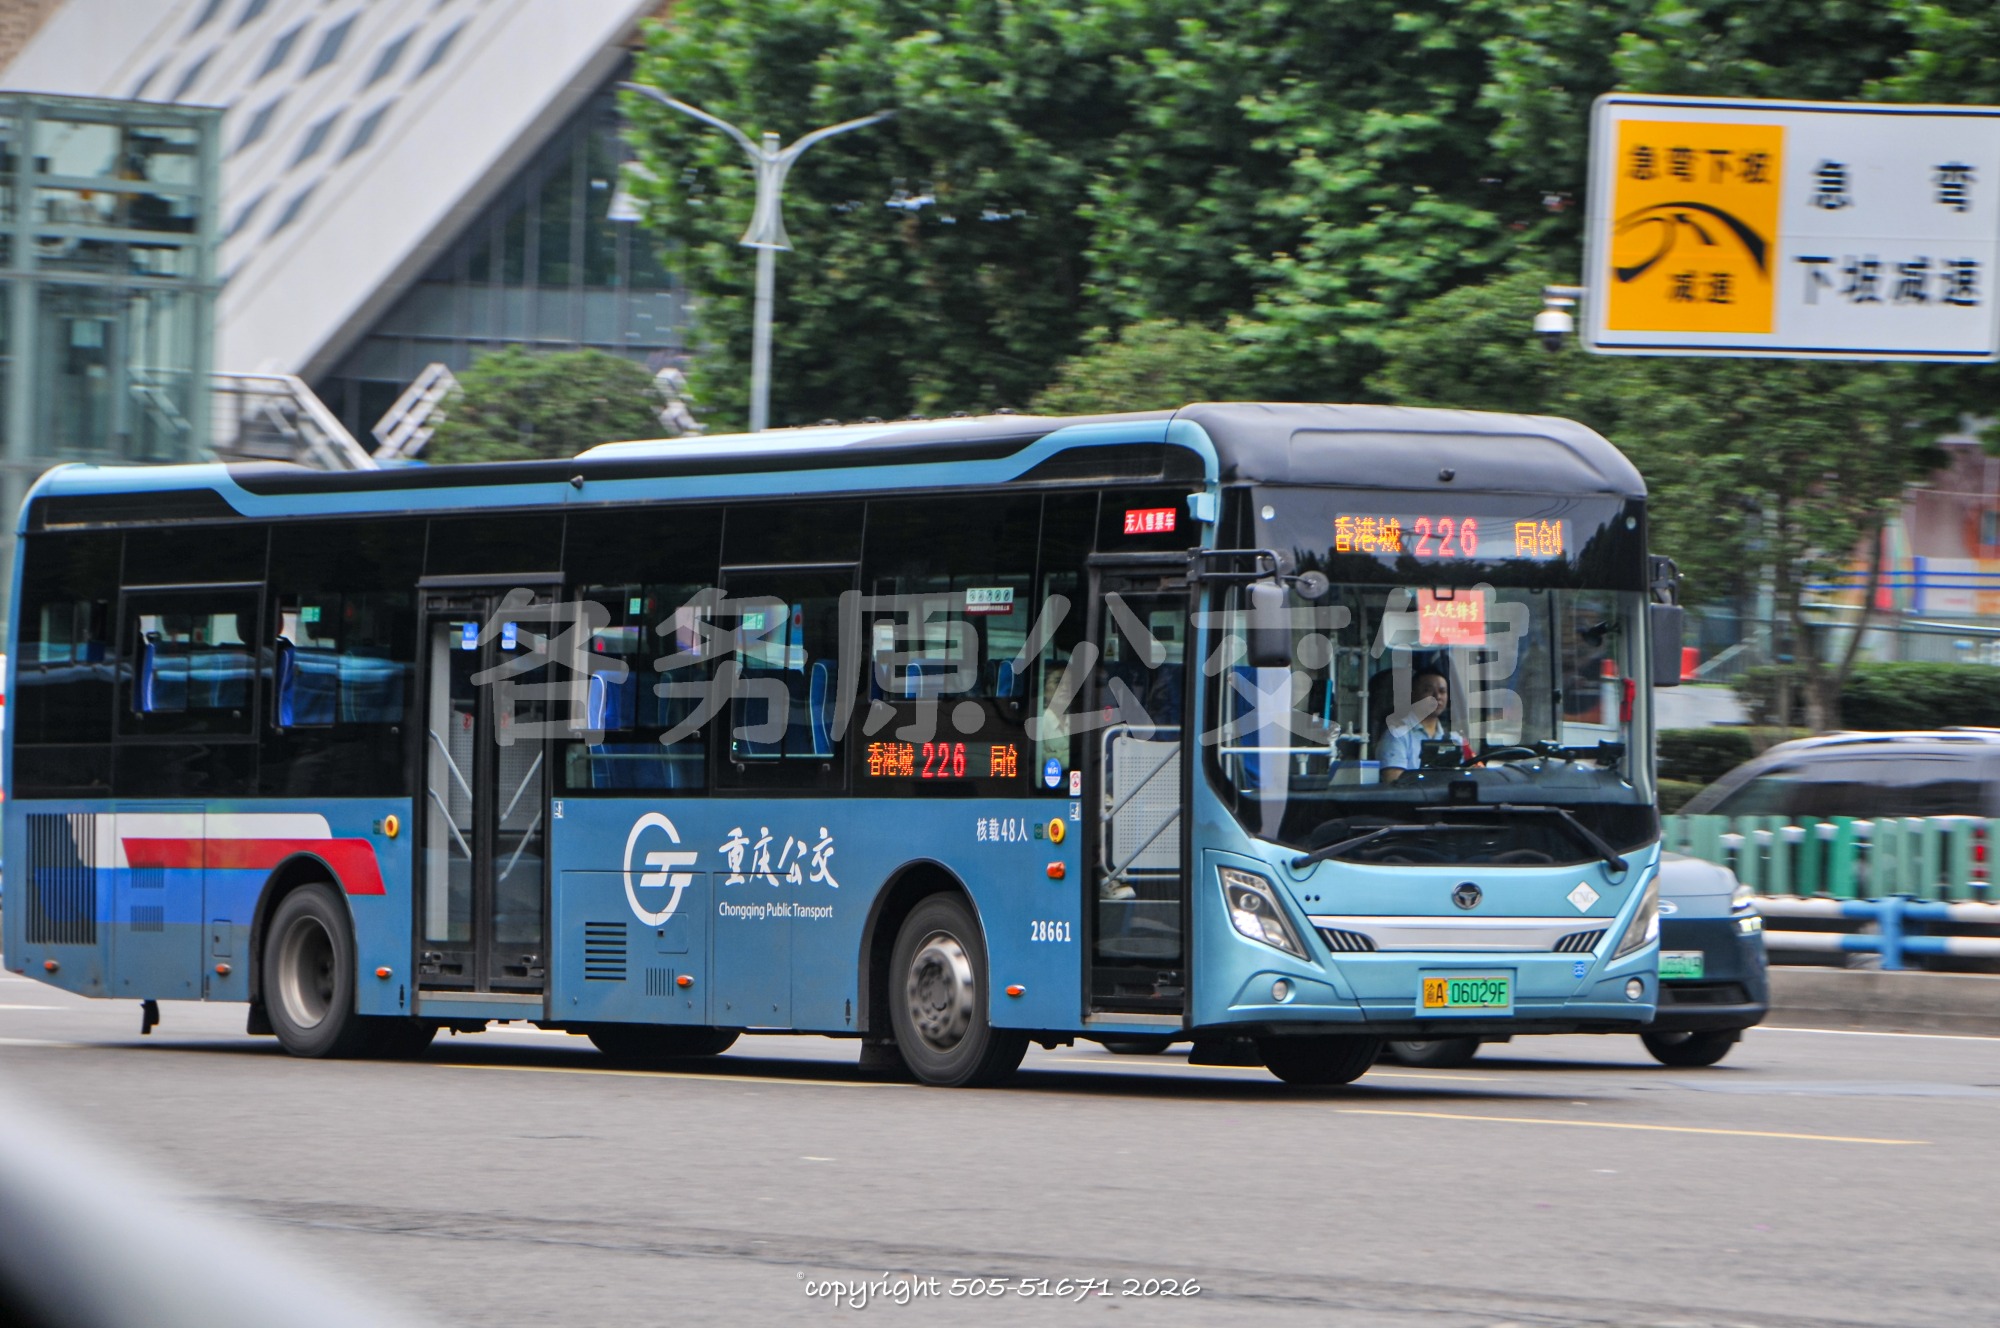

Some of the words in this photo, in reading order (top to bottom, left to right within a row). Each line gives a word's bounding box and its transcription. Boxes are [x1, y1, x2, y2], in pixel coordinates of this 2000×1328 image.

[1626, 144, 1771, 184] 急弯下坡
[1666, 269, 1736, 304] 减速
[1794, 253, 1981, 306] 下坡减速
[1125, 511, 1175, 532] 无人售票车
[1334, 515, 1402, 553] 香港城
[1414, 516, 1479, 557] 226
[1514, 520, 1564, 556] 同创
[1423, 601, 1479, 621] 工人先锋号
[867, 742, 914, 776] 香港城
[921, 742, 966, 778] 226
[976, 817, 1028, 842] 核载48人
[718, 826, 839, 888] 重庆公交
[718, 901, 765, 920] Chongqing
[766, 902, 792, 918] Public
[792, 903, 833, 920] Transport
[1030, 920, 1072, 942] 28661
